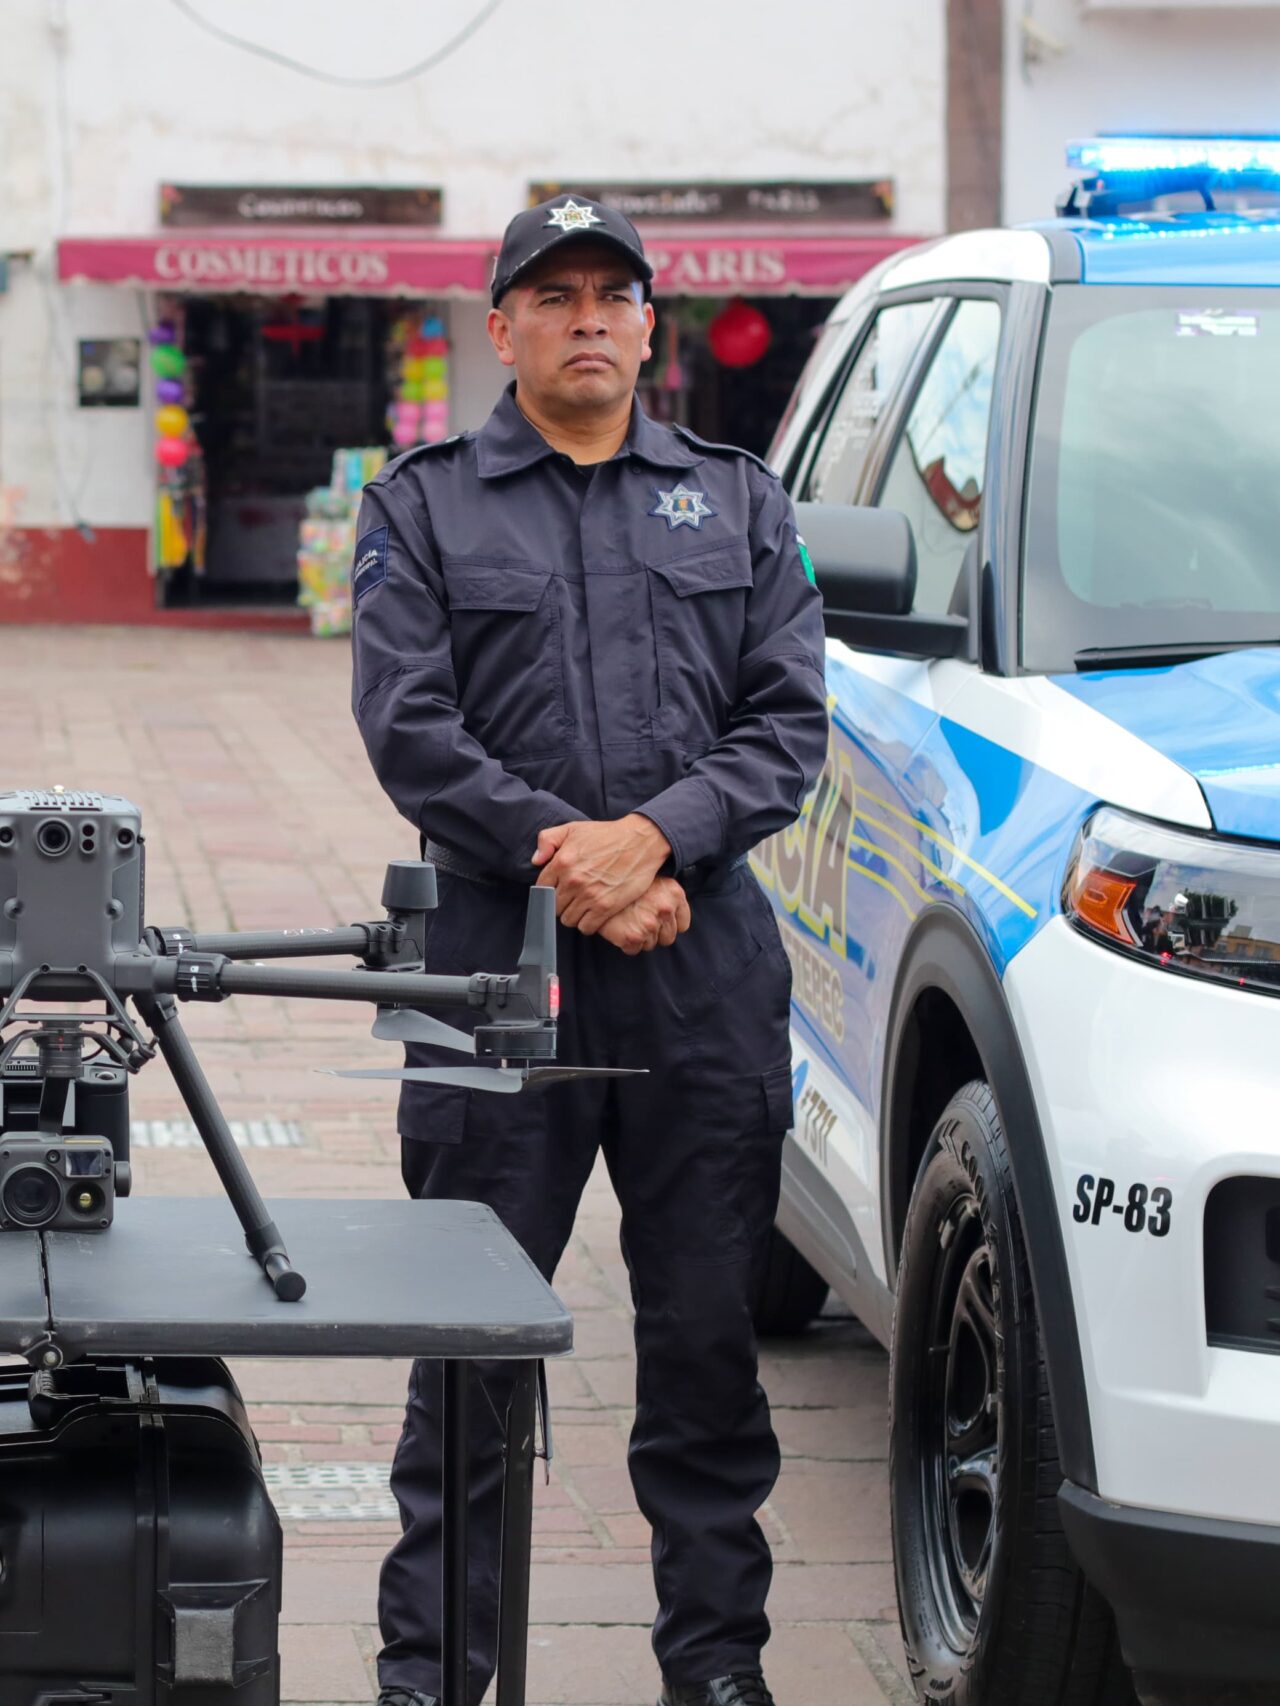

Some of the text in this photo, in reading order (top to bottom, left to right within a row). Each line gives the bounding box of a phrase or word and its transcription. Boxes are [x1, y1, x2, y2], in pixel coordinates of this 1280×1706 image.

[153, 245, 389, 283] COSMETICOS
[652, 248, 786, 284] PARIS
[1072, 1173, 1173, 1238] SP-83
